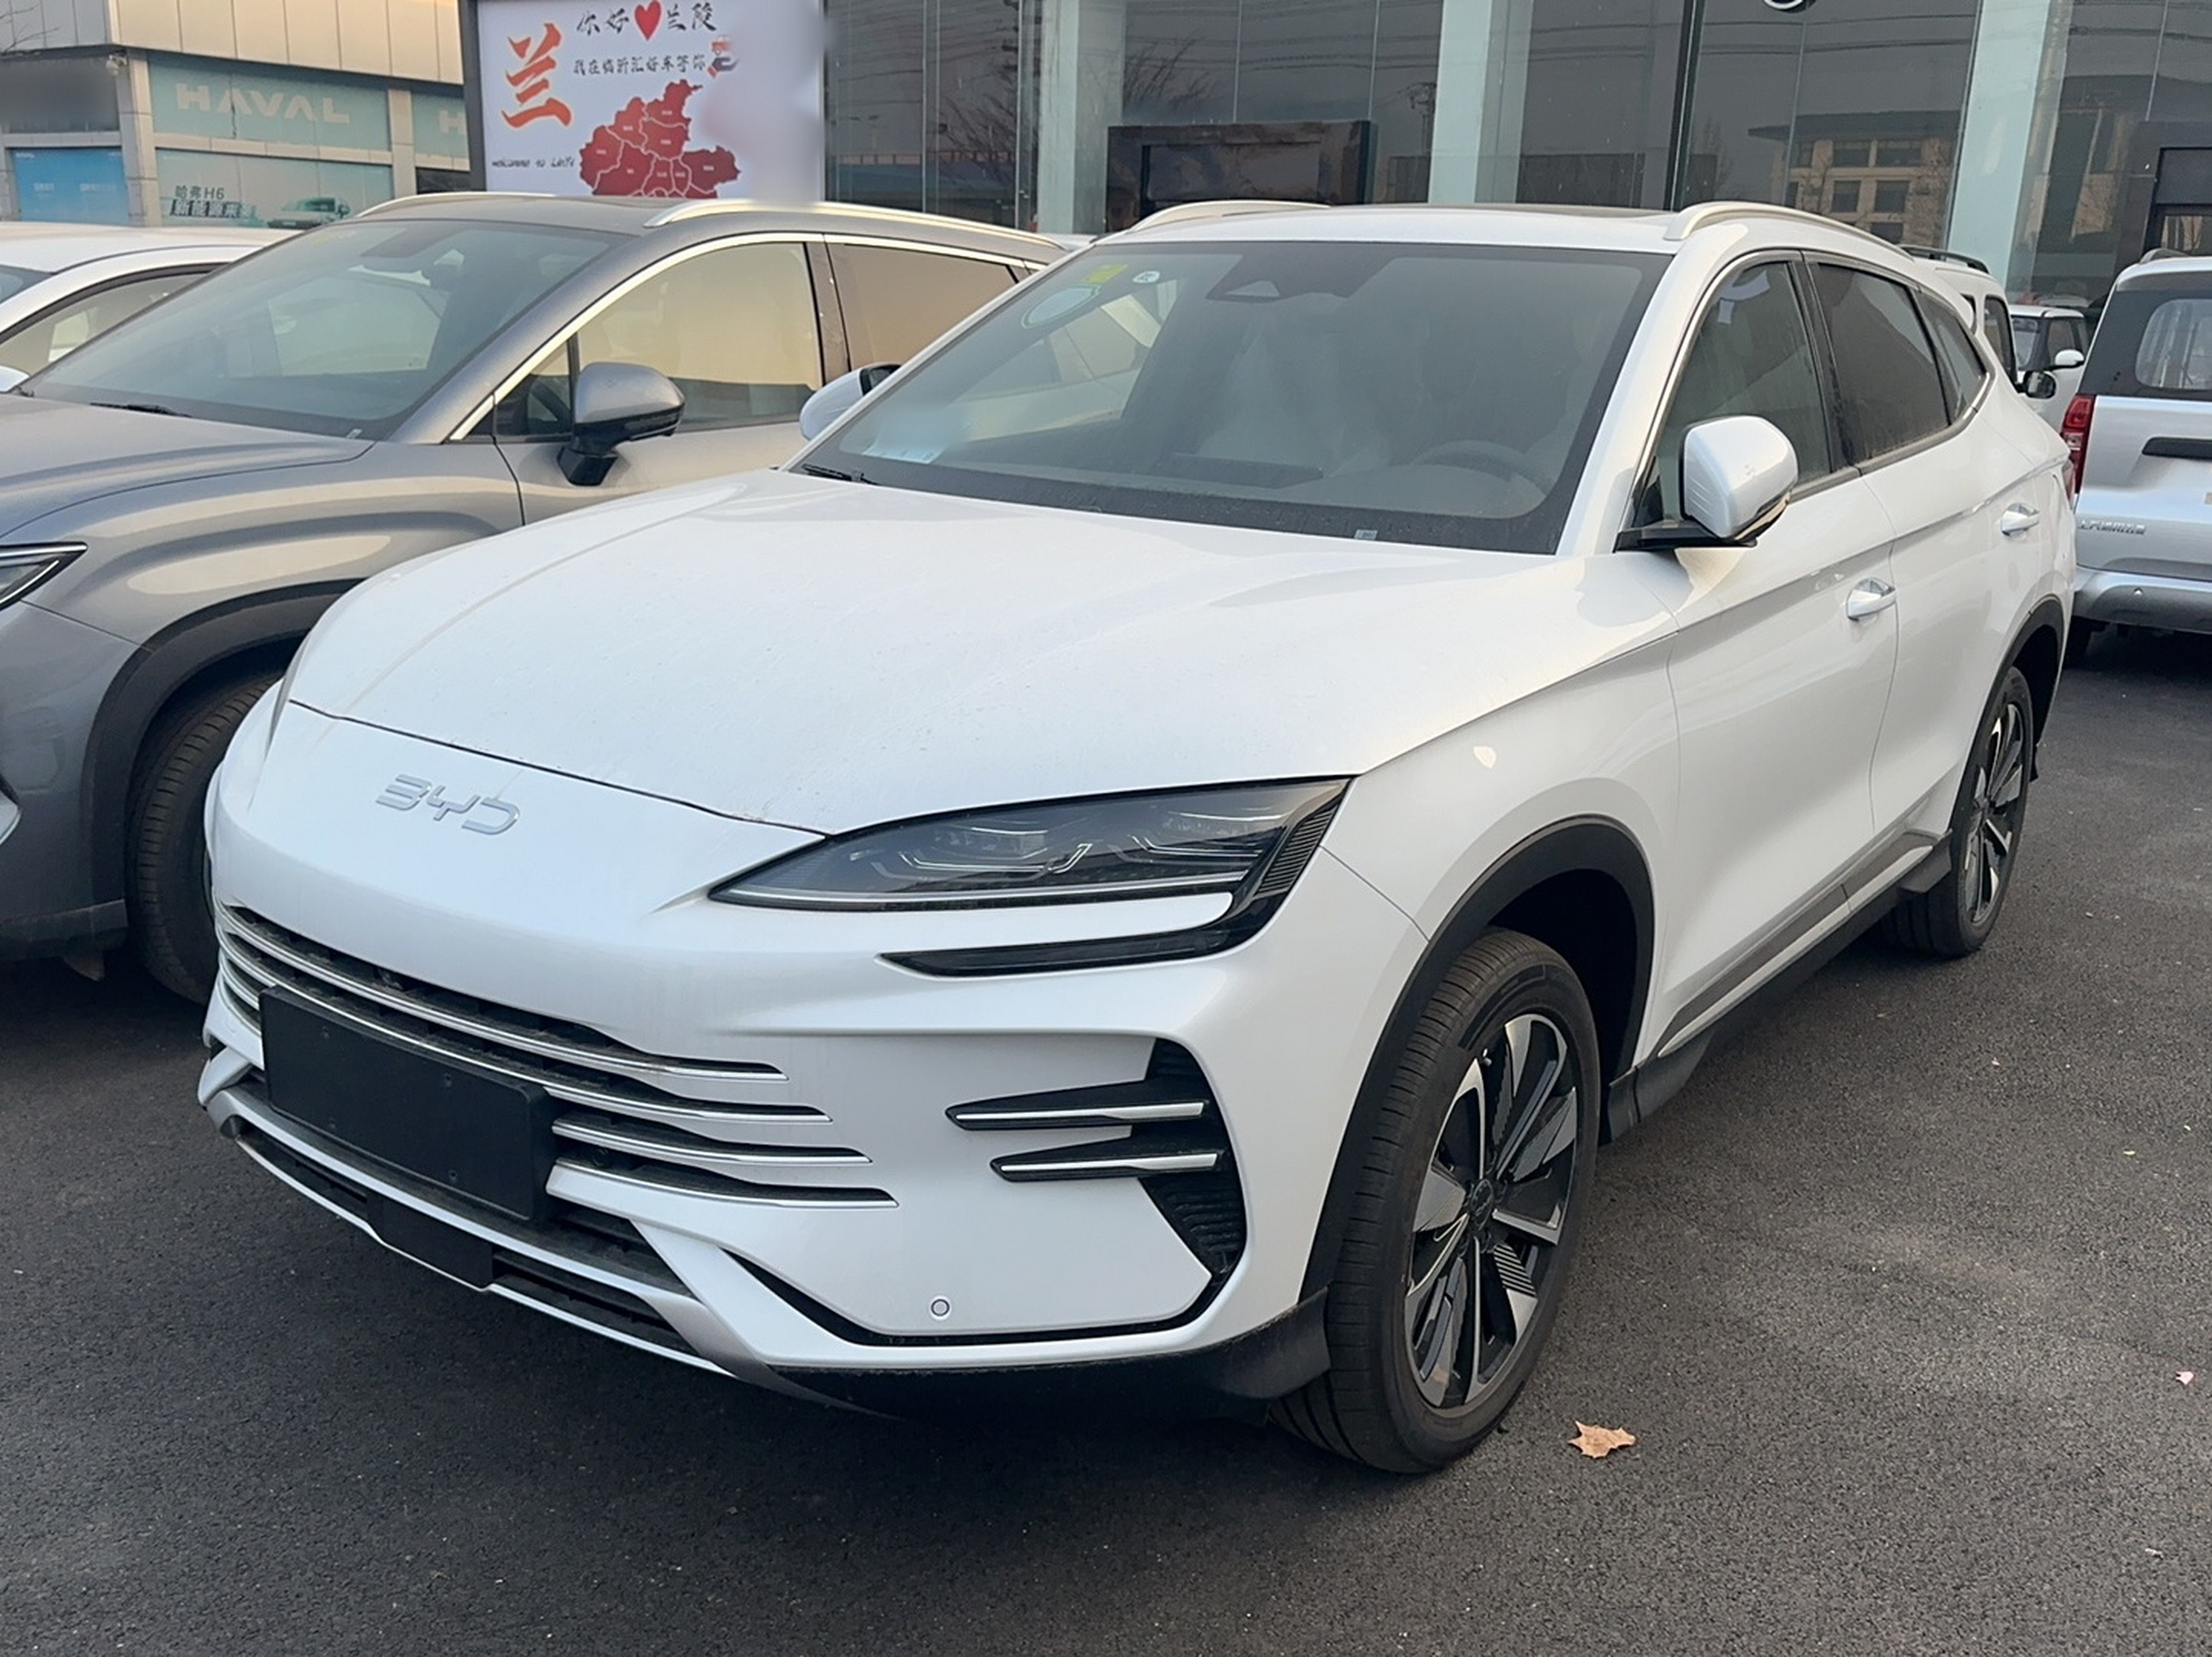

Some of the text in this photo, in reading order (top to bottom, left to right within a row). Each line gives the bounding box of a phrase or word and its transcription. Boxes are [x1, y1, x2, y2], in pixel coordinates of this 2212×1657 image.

[576, 8, 630, 36] 你好
[176, 82, 350, 123] HAVAL
[376, 774, 520, 835] BYD
